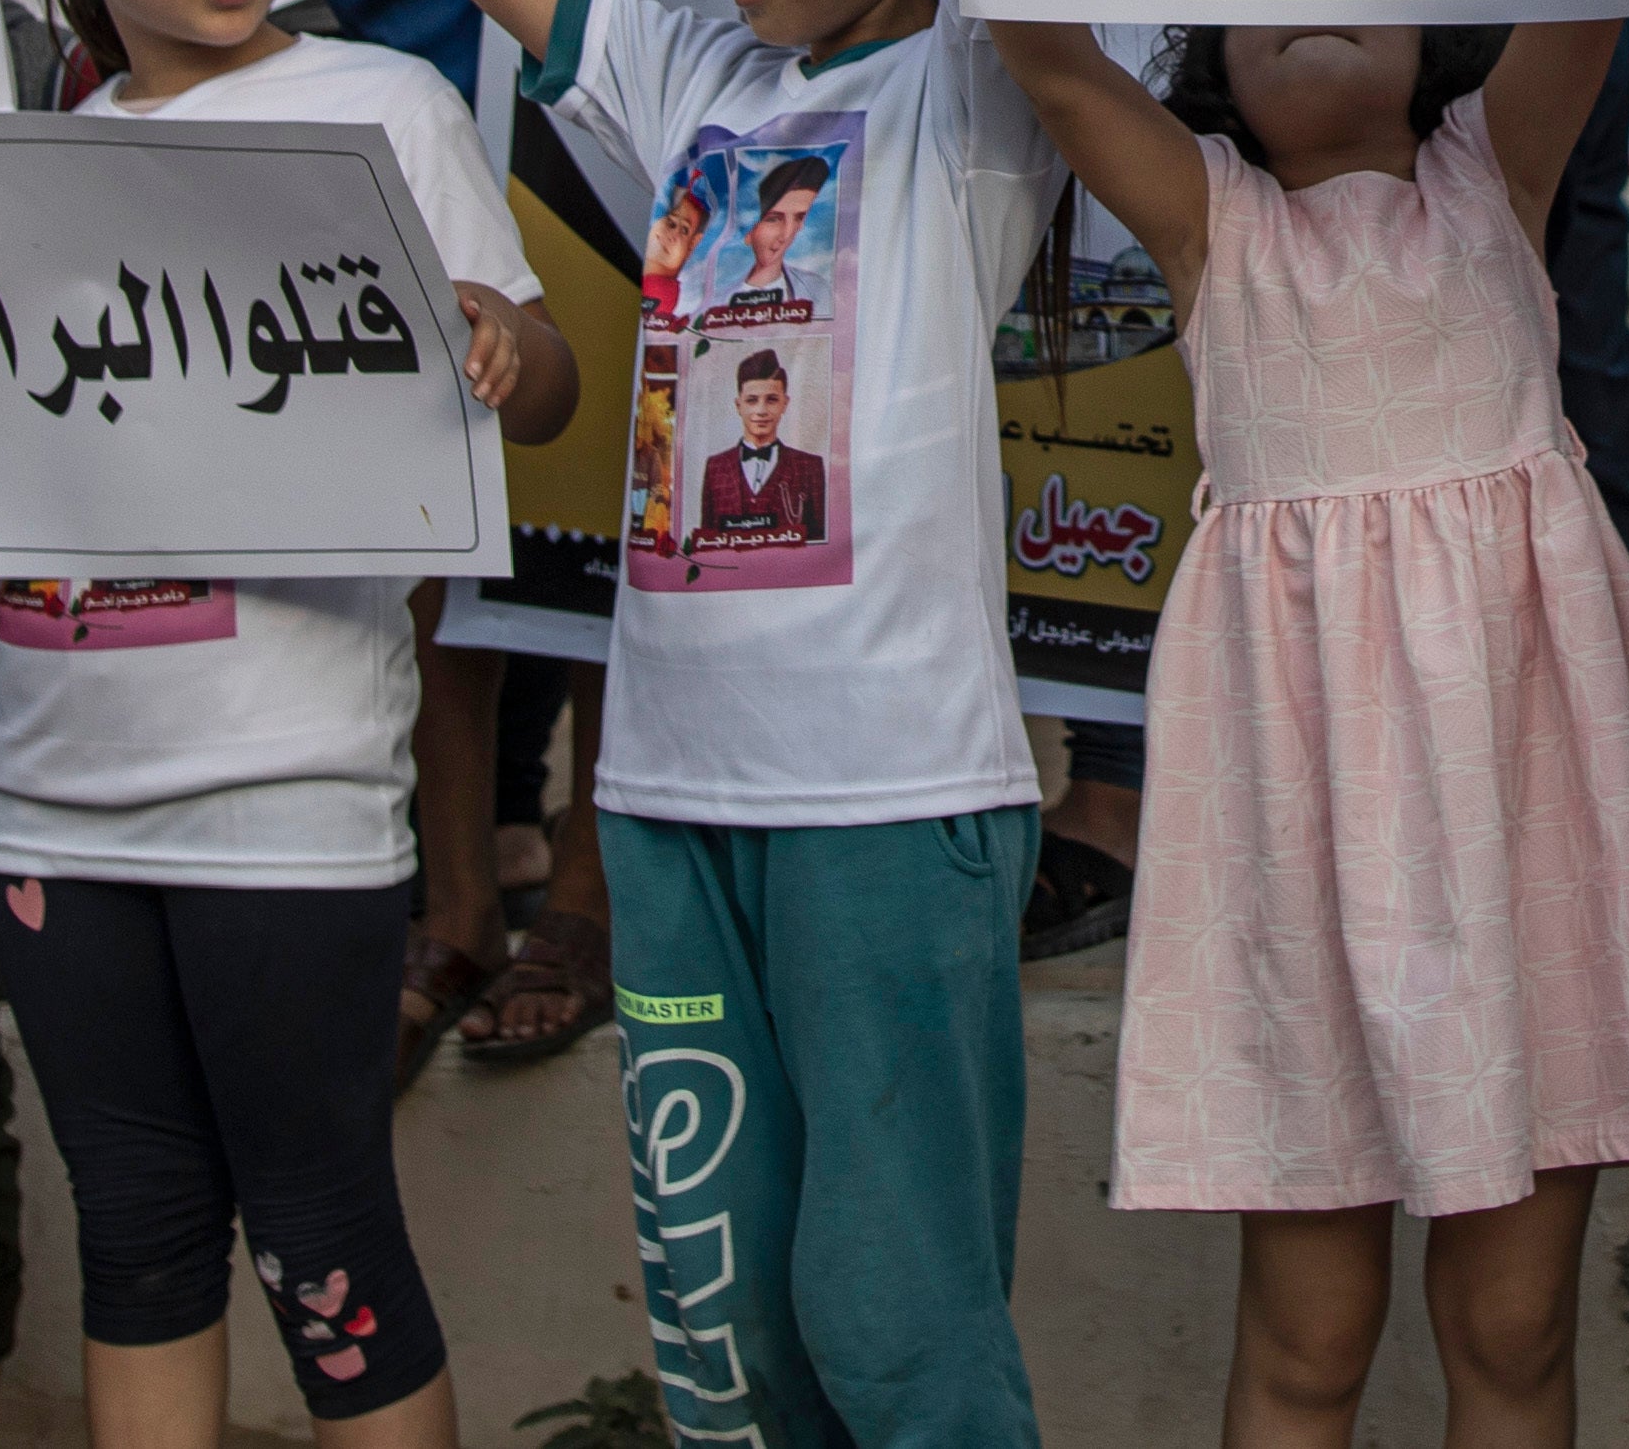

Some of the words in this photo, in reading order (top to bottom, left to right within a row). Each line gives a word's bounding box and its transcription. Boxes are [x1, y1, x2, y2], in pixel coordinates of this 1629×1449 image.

[774, 308, 808, 321] جميل
[202, 254, 421, 415] قتلوا
[1032, 421, 1174, 457] تحتسب
[767, 529, 802, 542] حامد
[1016, 475, 1160, 581] جميل
